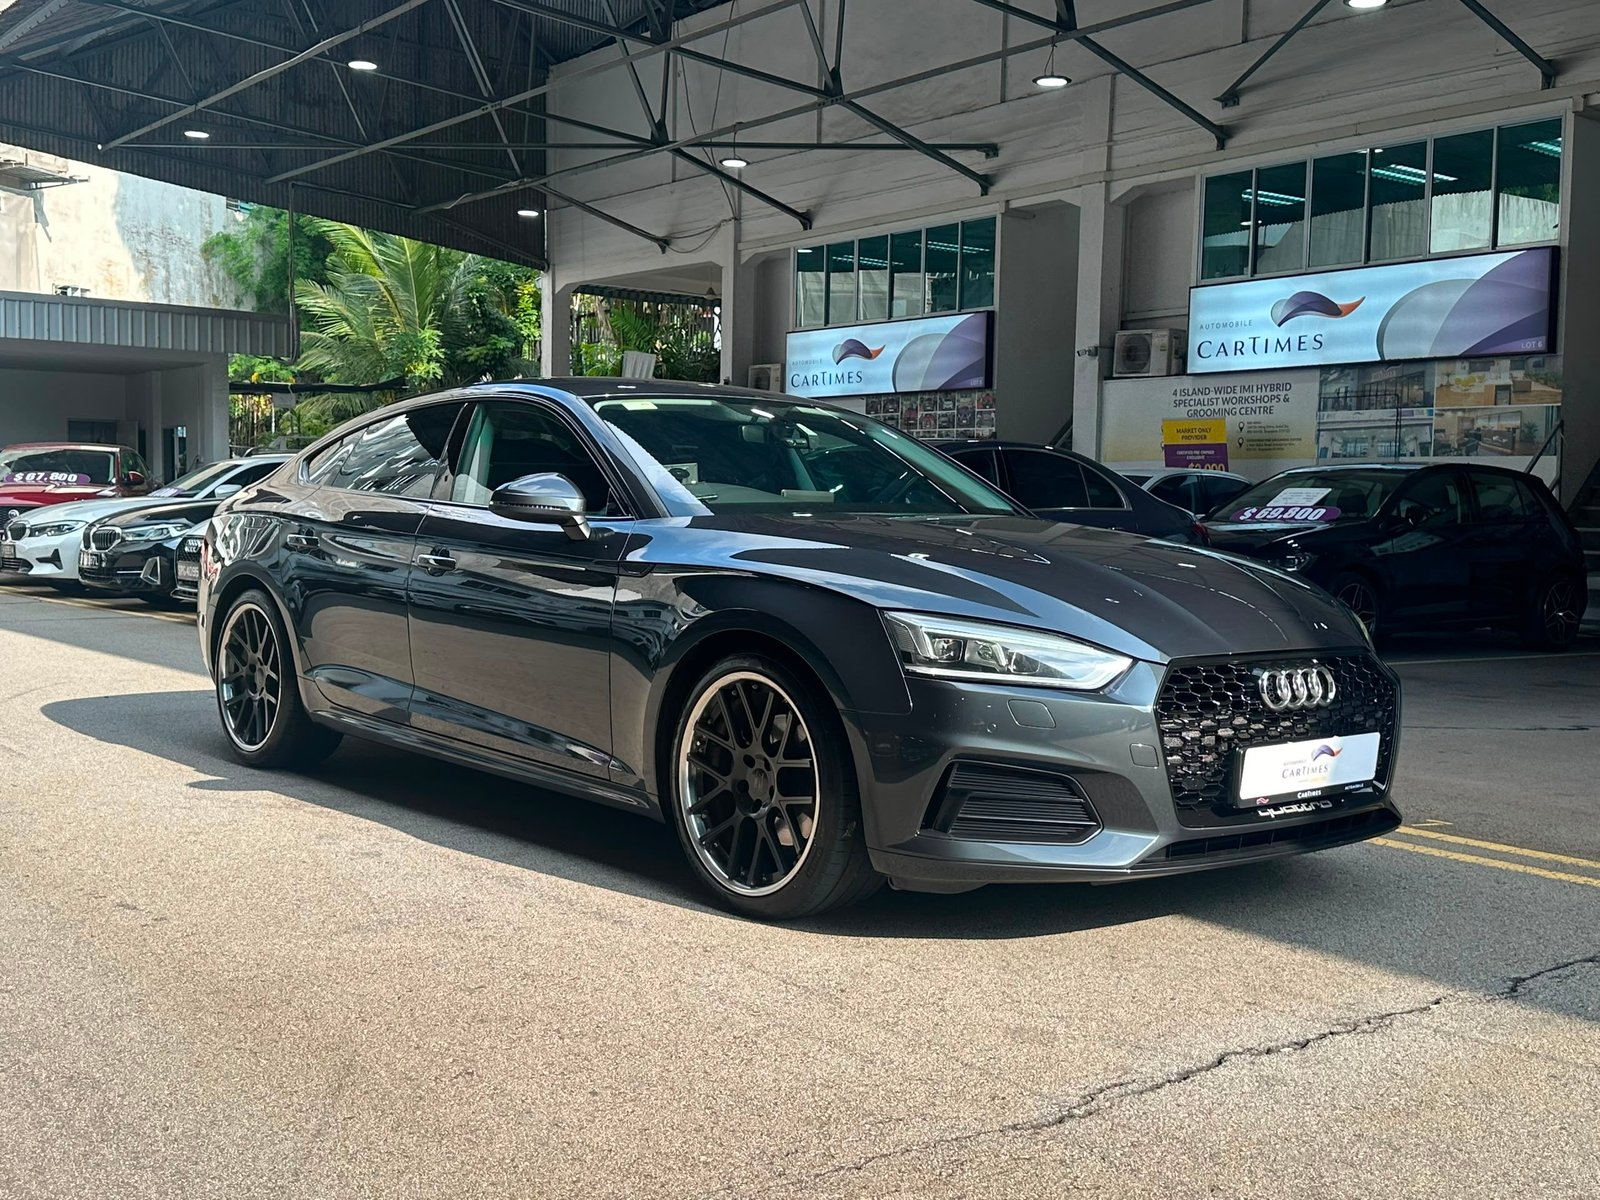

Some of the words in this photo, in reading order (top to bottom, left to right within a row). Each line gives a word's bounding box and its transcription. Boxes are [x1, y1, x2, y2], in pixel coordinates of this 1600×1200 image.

[1200, 320, 1253, 330] AUTOMOBILE
[1197, 333, 1324, 359] CARTIMES
[1521, 341, 1535, 349] LOT
[791, 371, 863, 388] CARTIMES
[1172, 388, 1178, 397] 4
[1179, 385, 1238, 397] ISLAND-WIDE
[1240, 383, 1254, 394] IMI
[1256, 382, 1292, 393] HYBRID
[1173, 397, 1220, 408] SPECIALIST
[1221, 395, 1281, 406] WORKSHOPS
[1283, 394, 1290, 403] &
[1187, 407, 1237, 418] GROOMING
[1238, 405, 1275, 416] CENTRE
[13, 472, 23, 482] $
[1239, 507, 1257, 520] $
[1259, 801, 1332, 818] quattro
